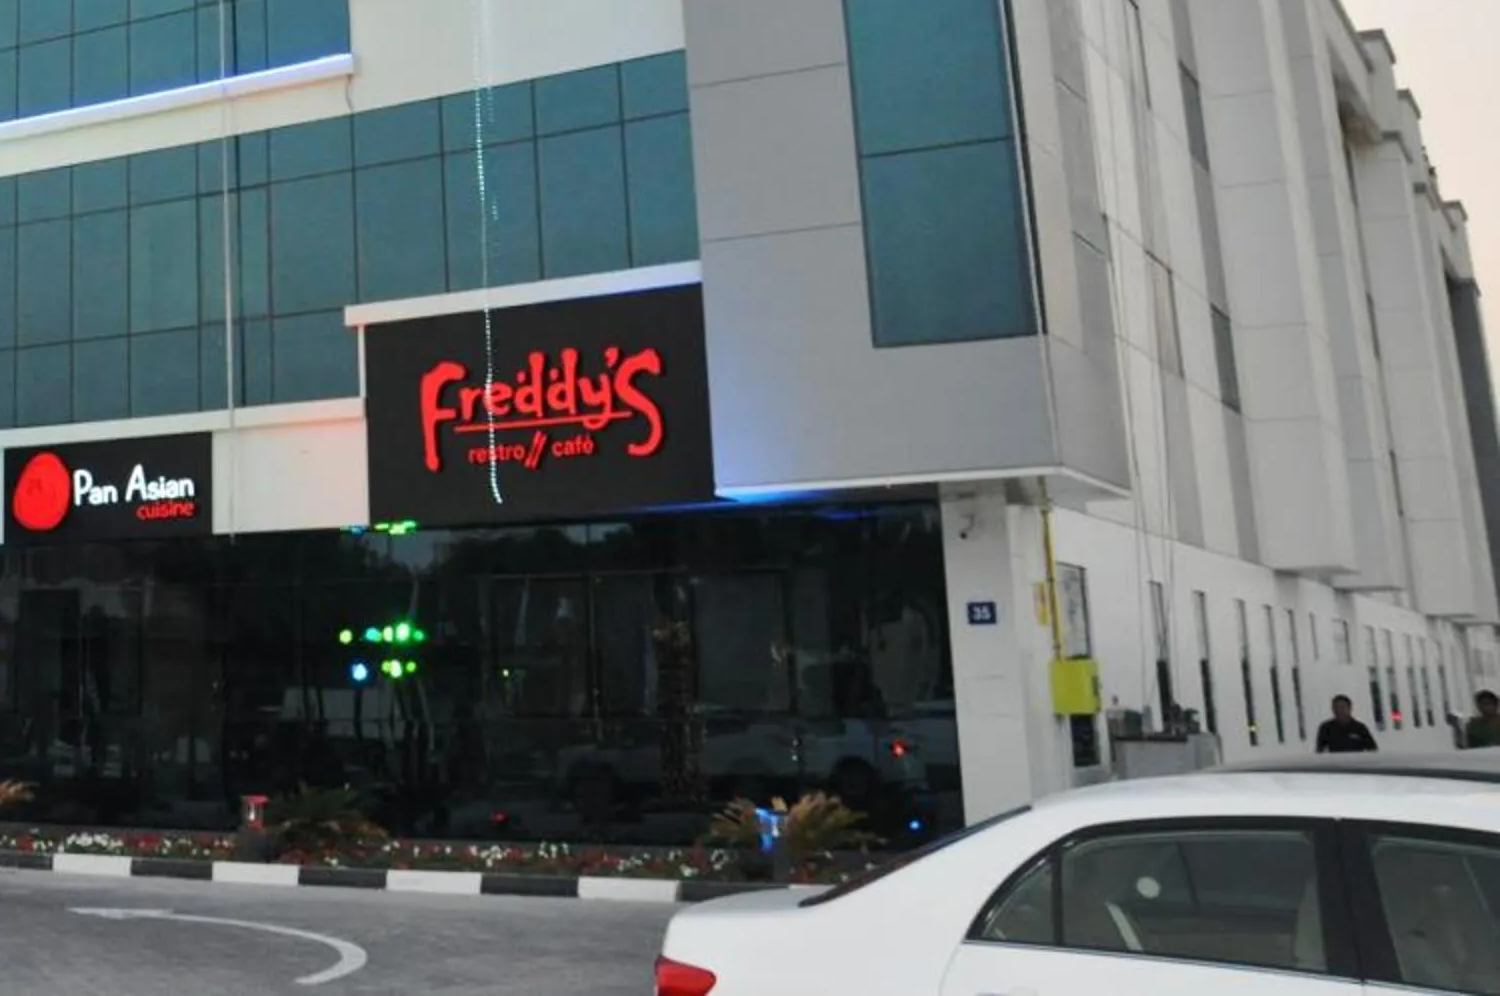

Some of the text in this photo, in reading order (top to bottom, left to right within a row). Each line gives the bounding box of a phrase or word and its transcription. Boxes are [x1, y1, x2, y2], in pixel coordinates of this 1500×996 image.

[73, 463, 195, 506] Pan Asian
[136, 500, 196, 520] cuisine
